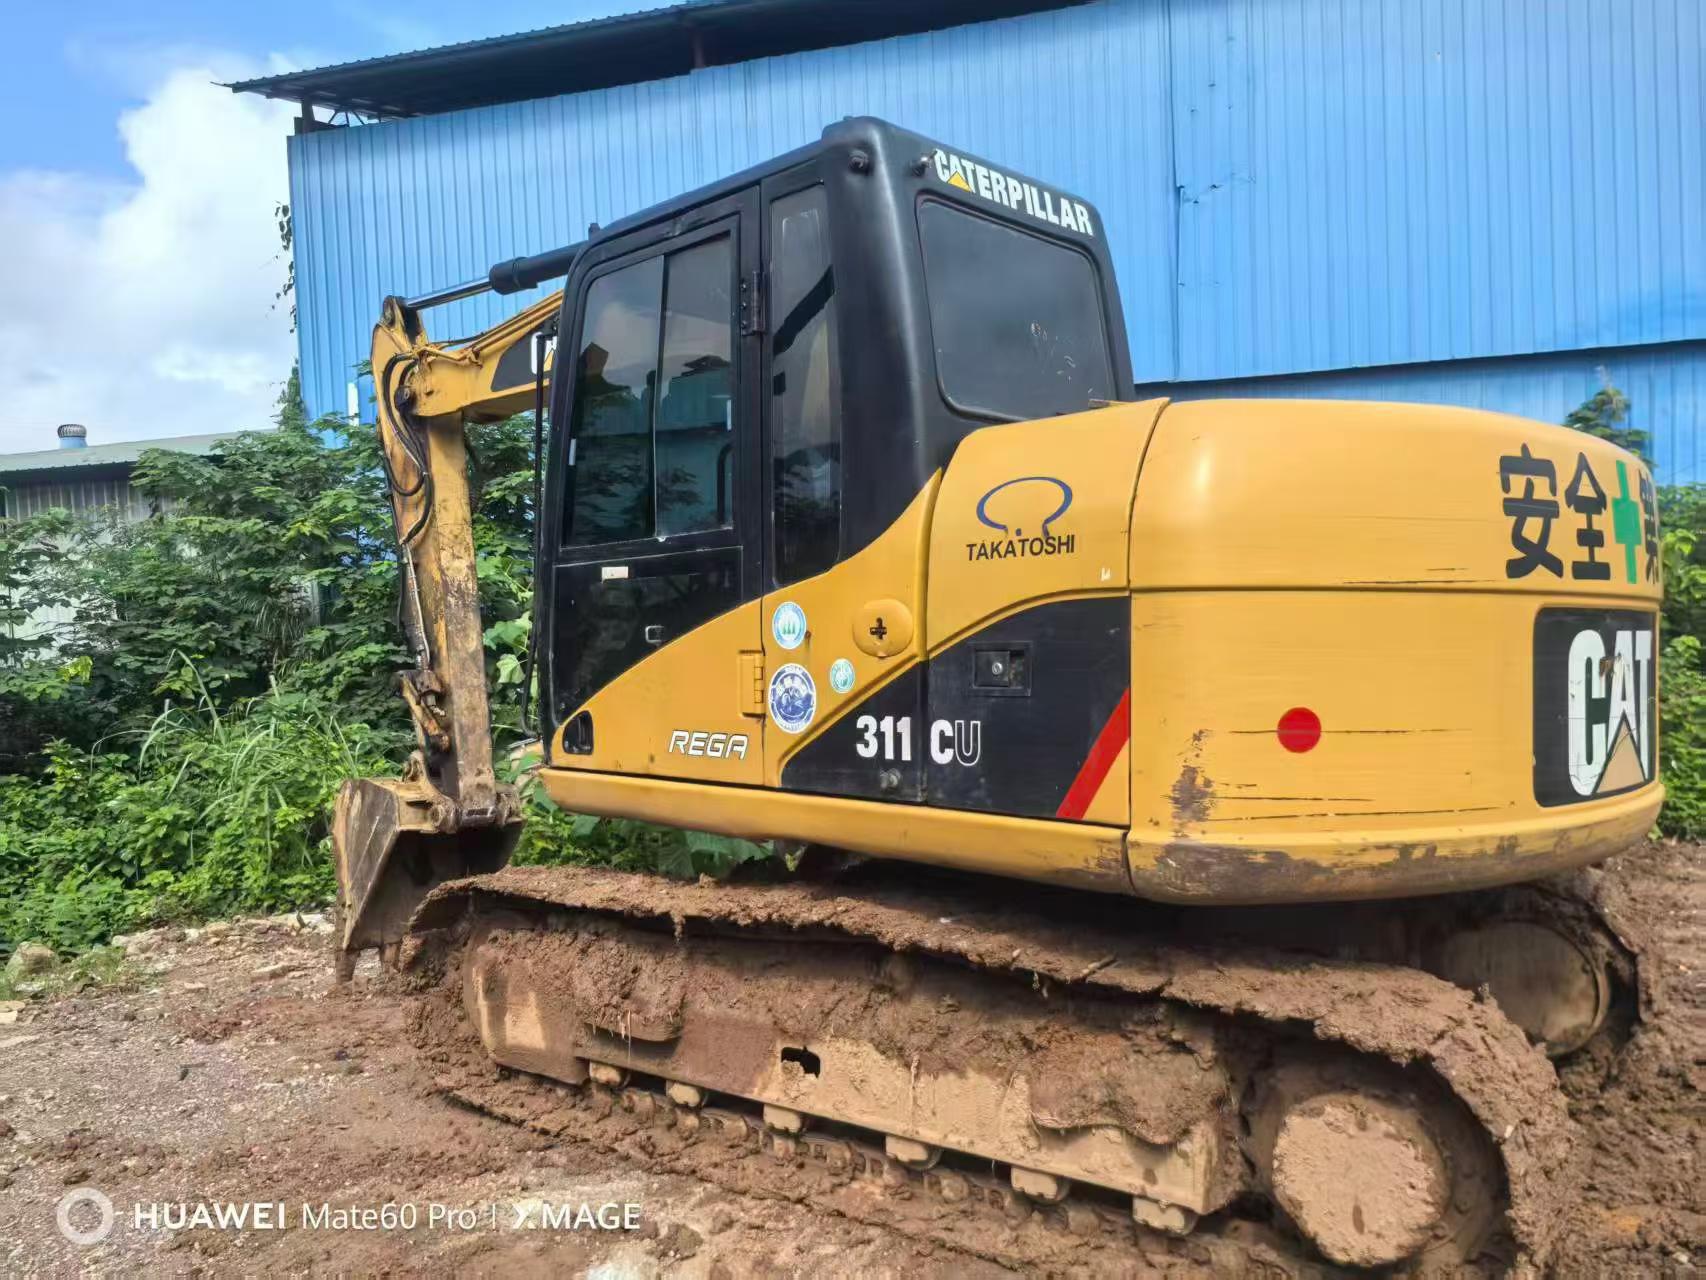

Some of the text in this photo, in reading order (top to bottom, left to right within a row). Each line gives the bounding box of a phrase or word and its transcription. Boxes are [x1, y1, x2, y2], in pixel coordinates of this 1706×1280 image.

[933, 148, 1094, 236] CATERPILLAR
[1499, 442, 1611, 581] 安全
[966, 534, 1076, 562] TAKATOSHI
[668, 729, 749, 760] REGA
[855, 714, 981, 767] 311 CU
[1568, 629, 1653, 797] CAT
